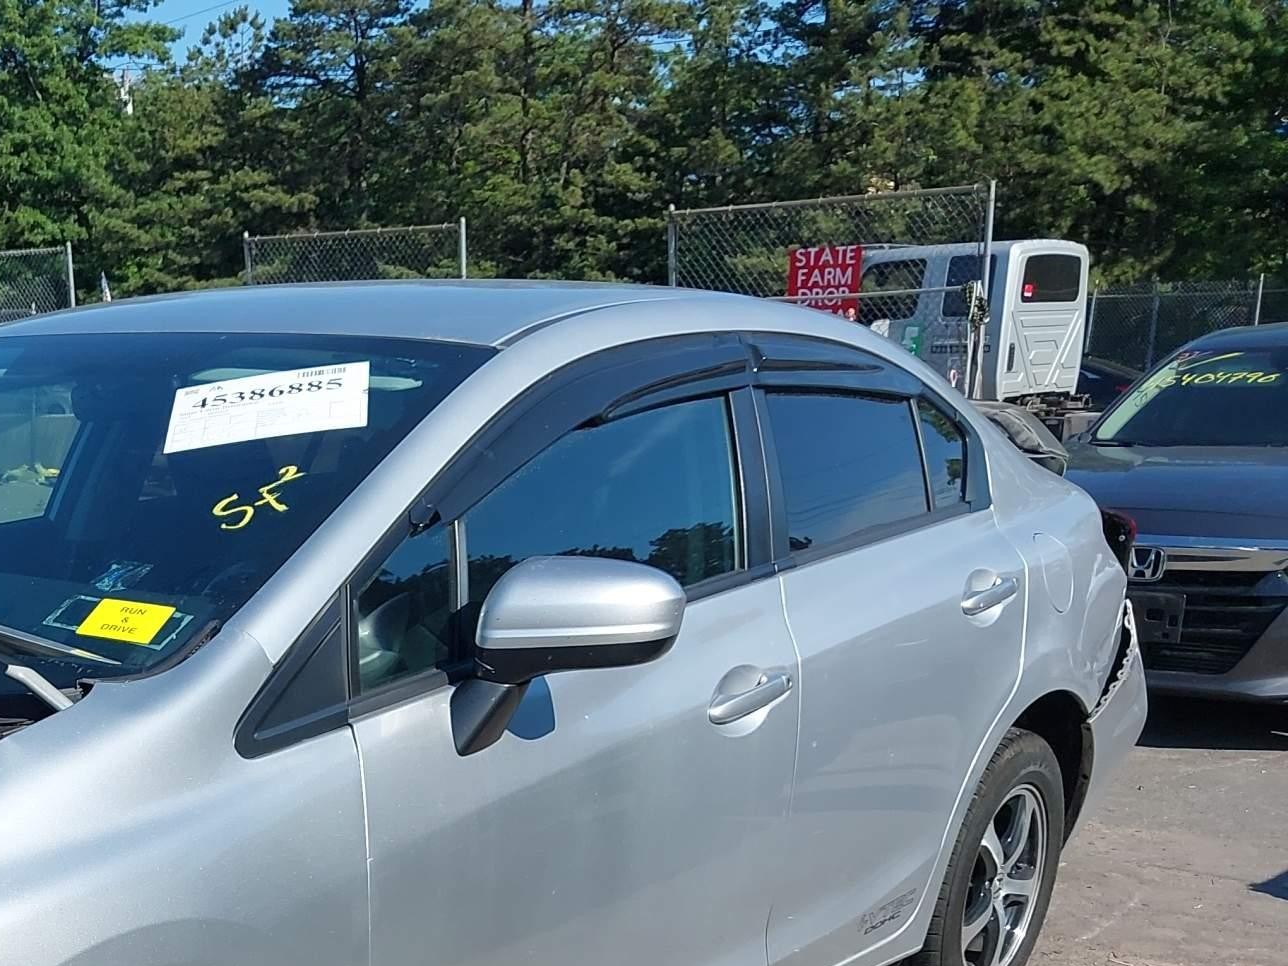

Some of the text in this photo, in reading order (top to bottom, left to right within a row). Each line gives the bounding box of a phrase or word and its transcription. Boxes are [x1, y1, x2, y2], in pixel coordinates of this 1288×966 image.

[795, 245, 857, 267] STATE
[797, 266, 853, 287] FARM
[797, 286, 850, 306] DROP
[192, 378, 343, 408] 45386885
[120, 606, 147, 615] RUN
[100, 623, 137, 634] DRIVE
